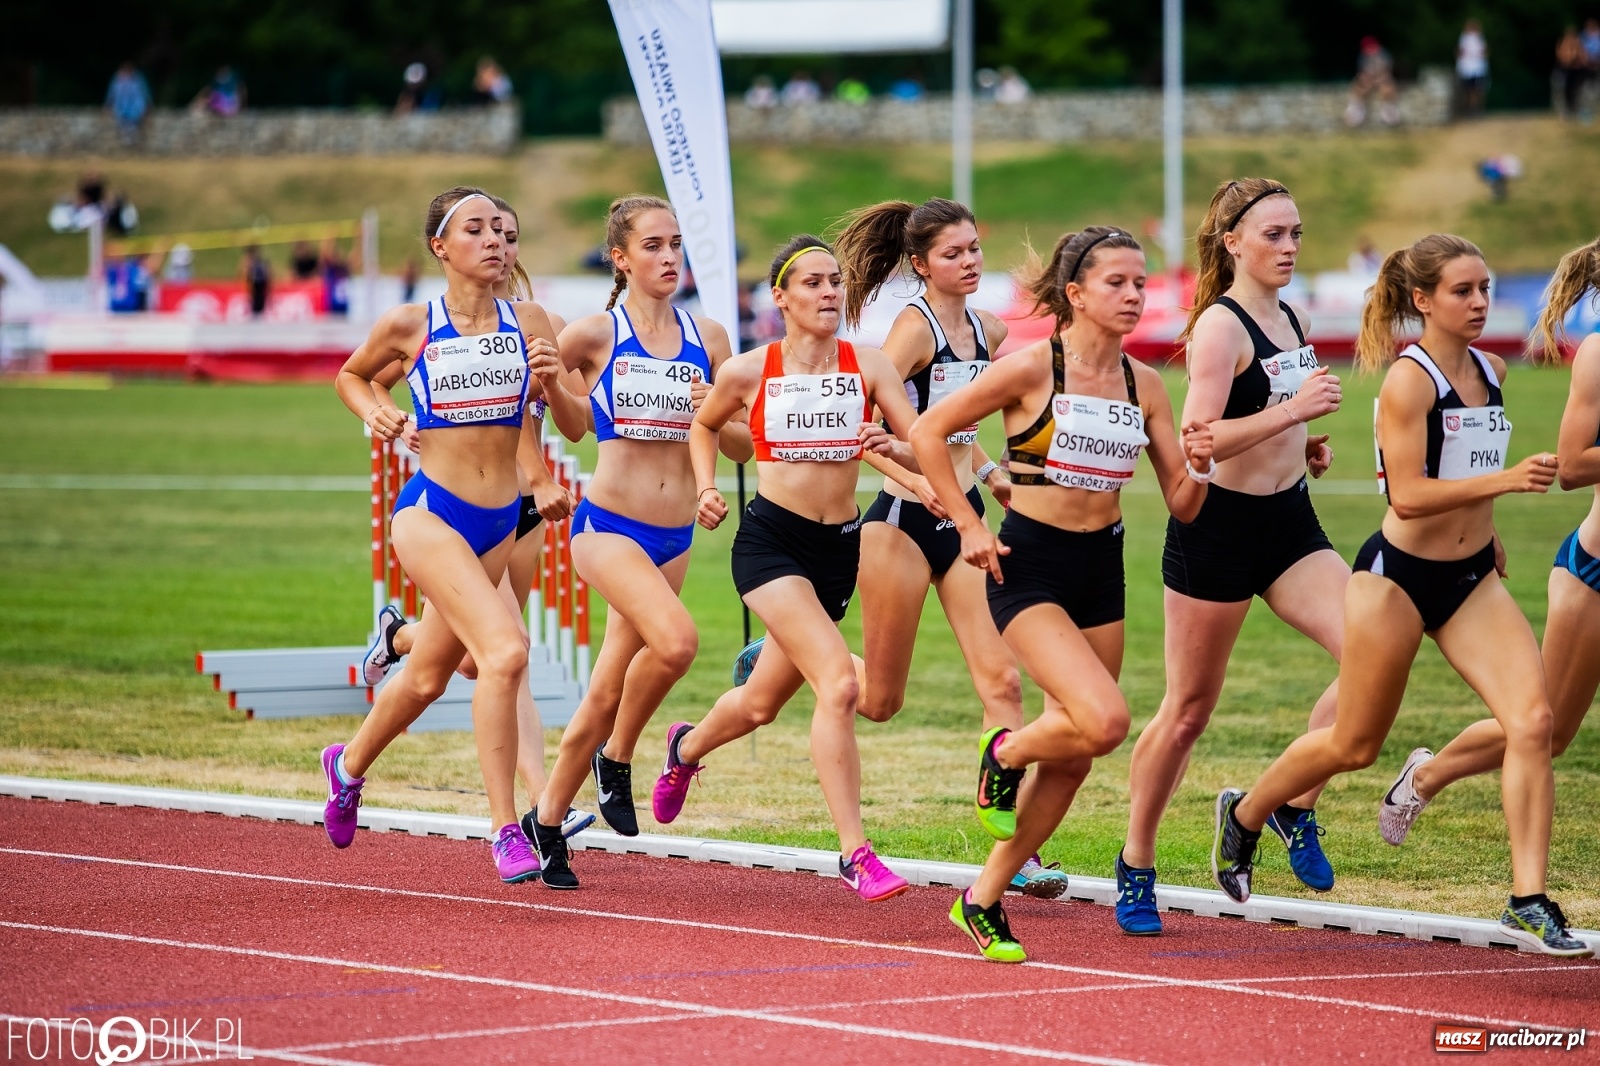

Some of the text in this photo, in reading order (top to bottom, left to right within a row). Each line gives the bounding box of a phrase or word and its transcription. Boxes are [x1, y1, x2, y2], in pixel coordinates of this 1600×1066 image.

[441, 348, 469, 356] Racibórz
[478, 336, 518, 356] 380
[433, 368, 523, 391] JABŁOŃSKA
[630, 367, 657, 375] Racibórz
[783, 386, 811, 394] Racibórz
[821, 377, 858, 397] 554
[616, 392, 696, 413] SŁOMIŃSK
[443, 405, 516, 421] RACIBÓRZ 2019
[786, 411, 848, 430] FIUTEK
[1108, 404, 1140, 430] 555
[623, 427, 686, 440] RACIBÓRZ 2019
[778, 448, 854, 460] RACIBÓRZ 2019
[1056, 432, 1141, 460] OSTROWSKA
[1470, 449, 1500, 468] PYKA
[1056, 472, 1104, 489] RACIBÓRZ
